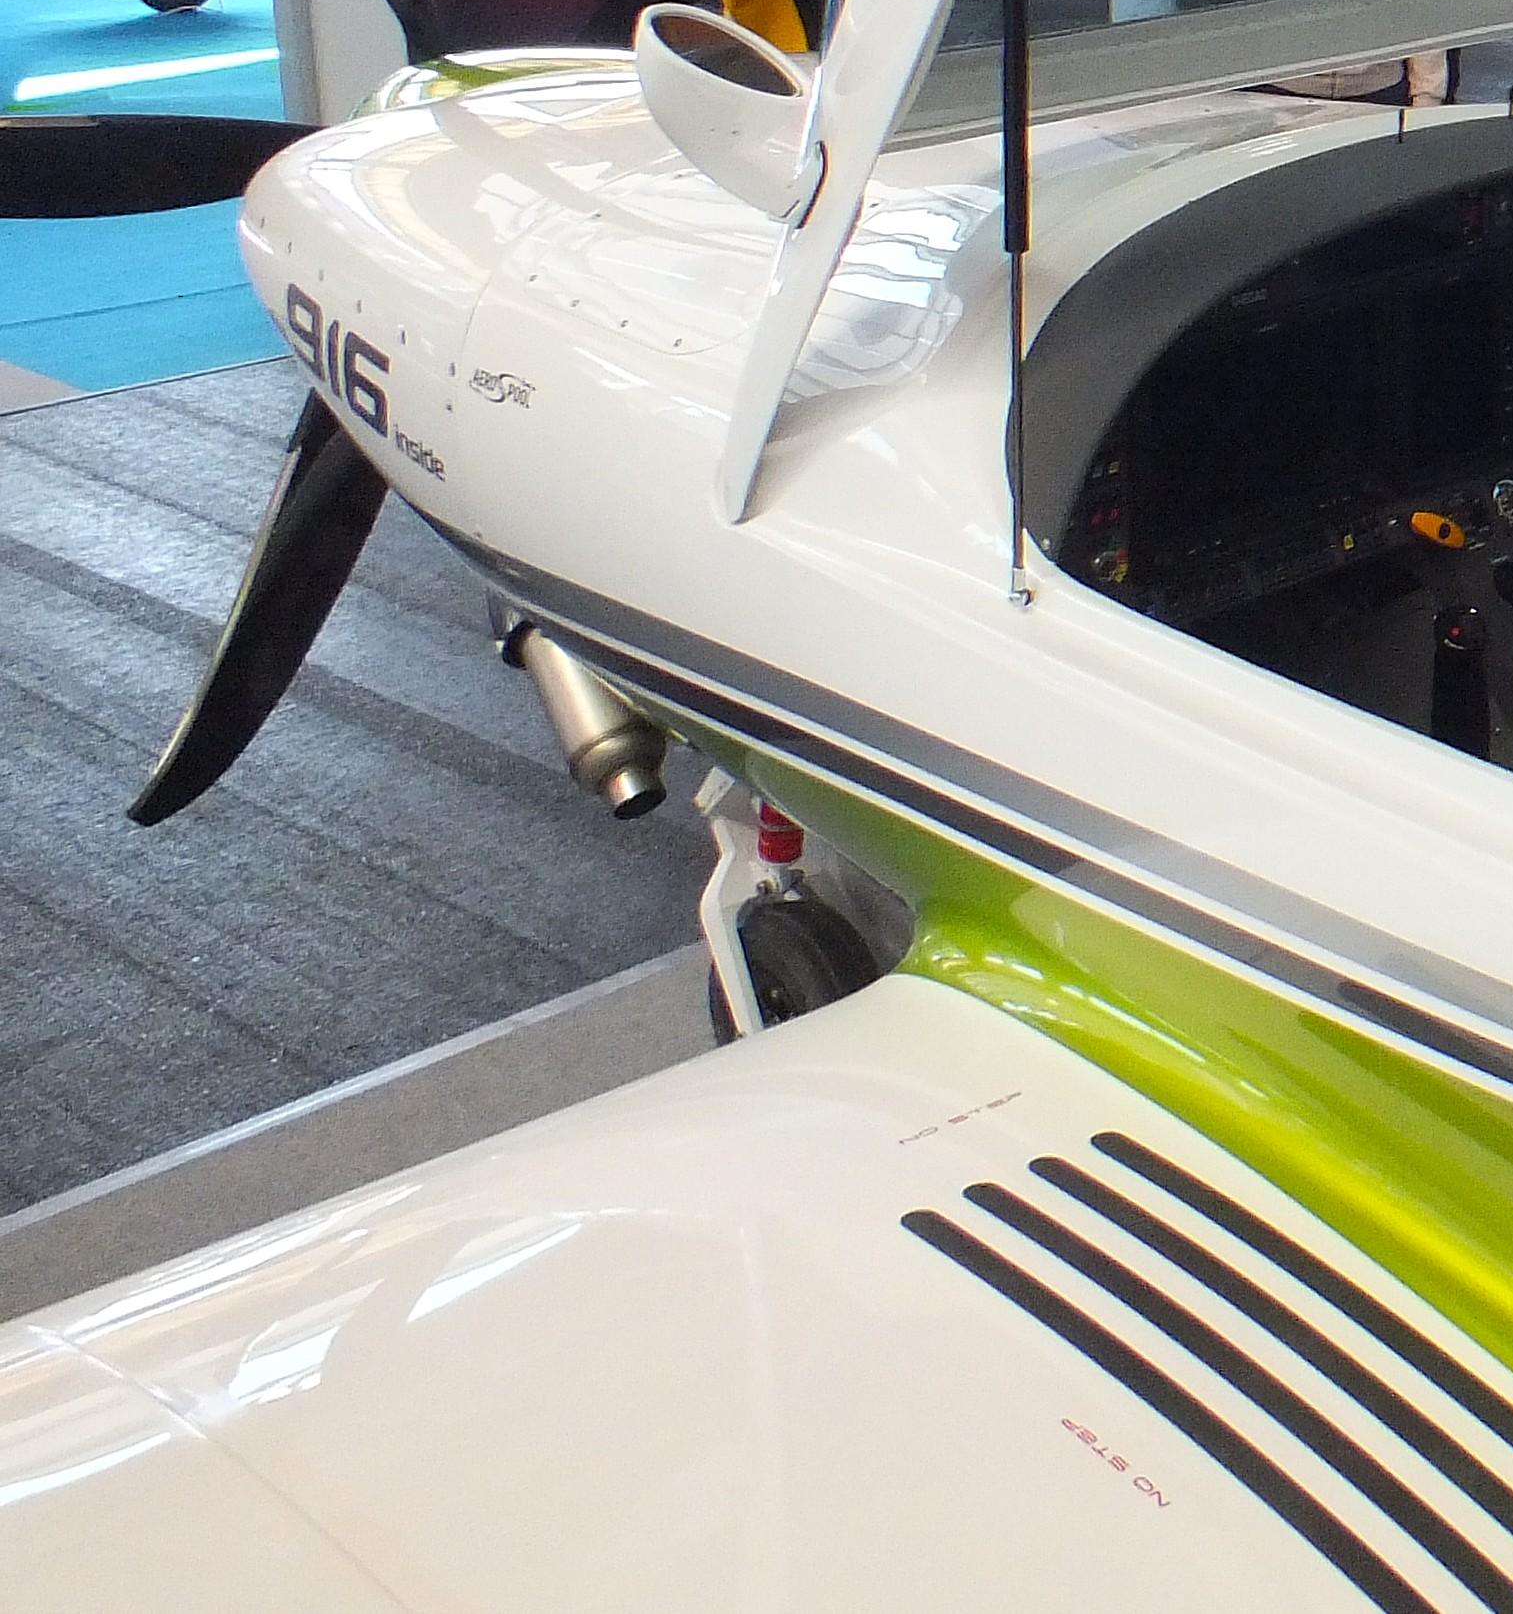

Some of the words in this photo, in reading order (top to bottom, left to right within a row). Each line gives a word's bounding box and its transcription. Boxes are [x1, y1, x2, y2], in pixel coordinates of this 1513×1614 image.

[287, 283, 390, 438] 916
[394, 422, 447, 483] inside
[1061, 1417, 1132, 1473] STEP
[1132, 1475, 1171, 1508] NO
